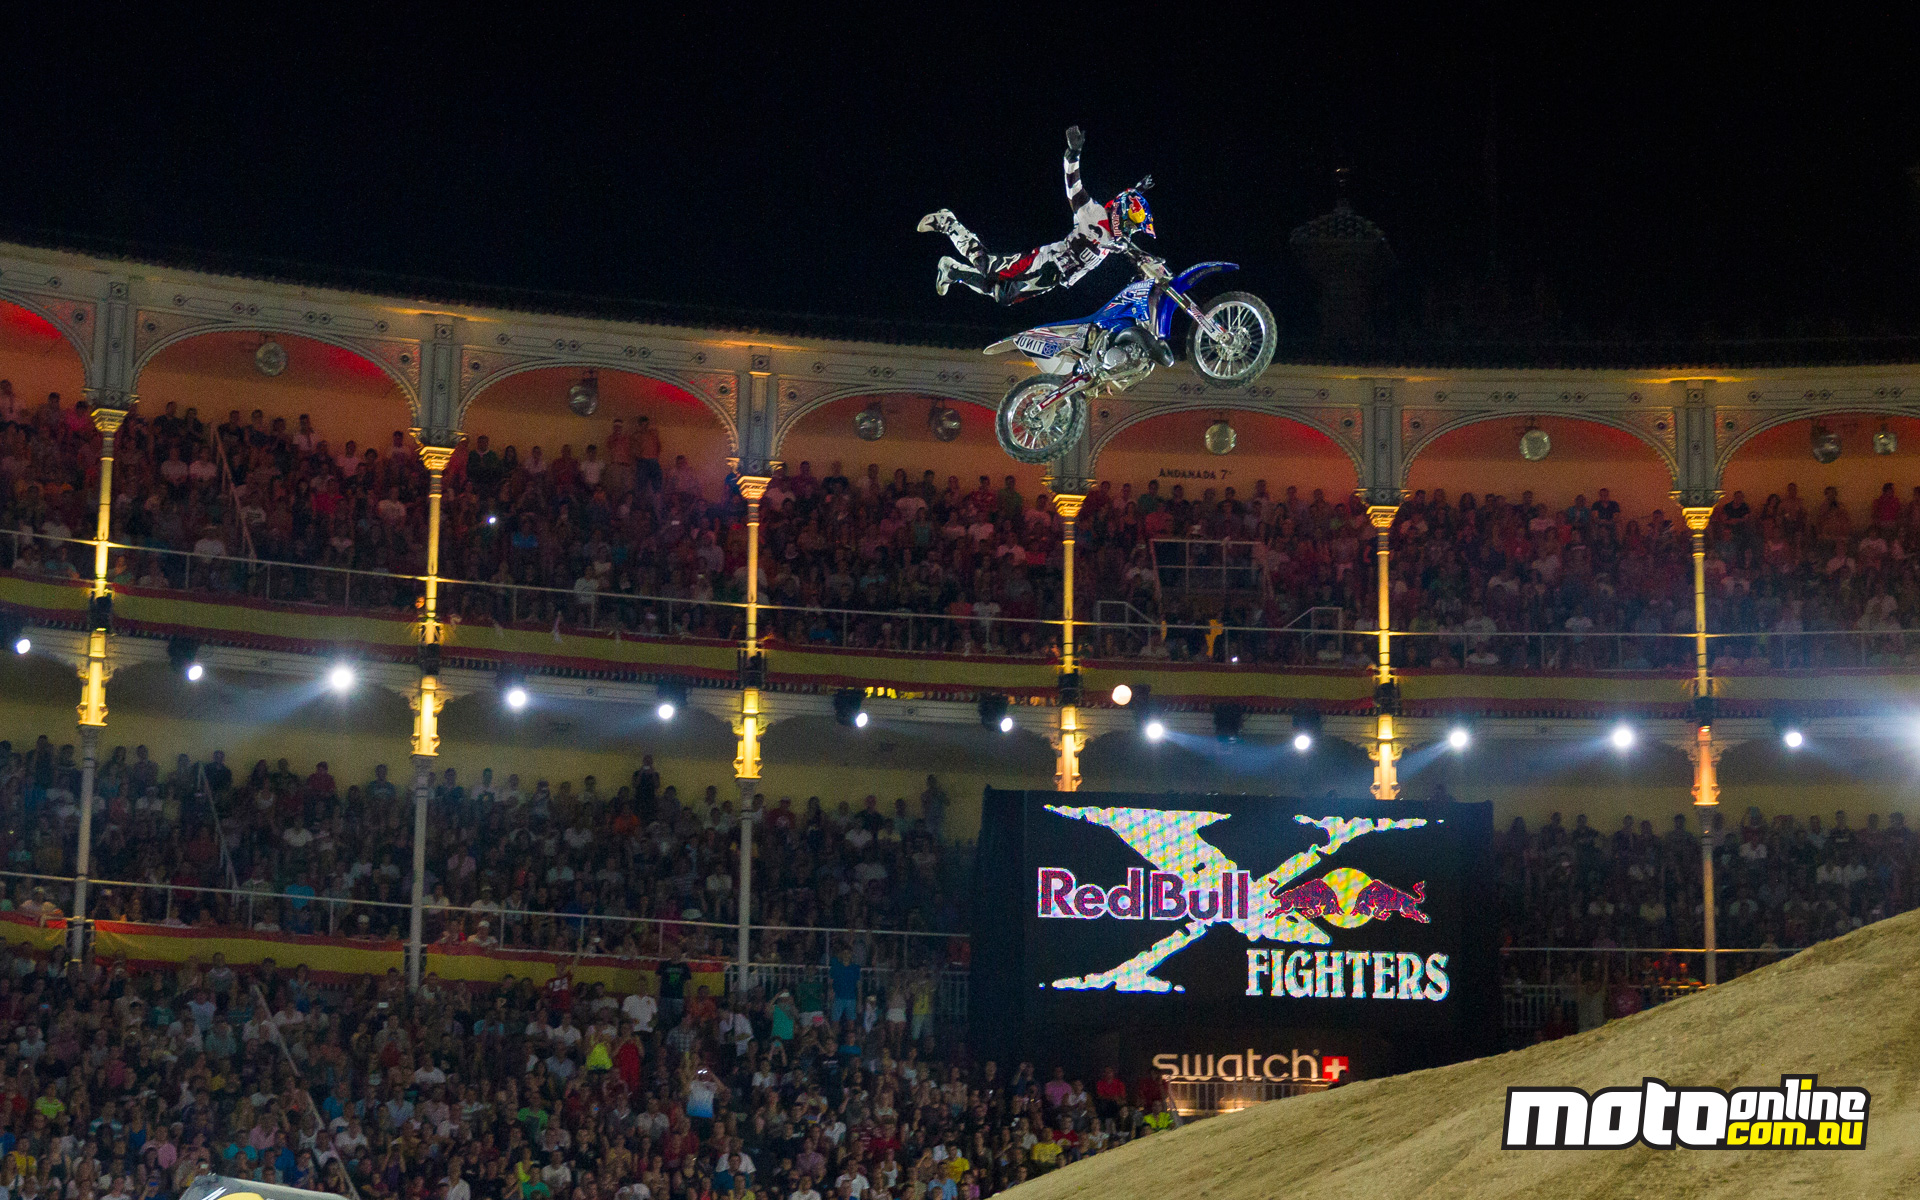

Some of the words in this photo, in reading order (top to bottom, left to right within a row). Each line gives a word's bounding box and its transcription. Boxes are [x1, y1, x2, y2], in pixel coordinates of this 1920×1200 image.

[1019, 336, 1045, 353] UNIT
[1159, 468, 1216, 480] ANDANADA
[1037, 867, 1144, 920] Red
[1150, 869, 1251, 921] Bull
[1245, 948, 1450, 1001] FIGHTERS
[1152, 1048, 1318, 1082] swatch
